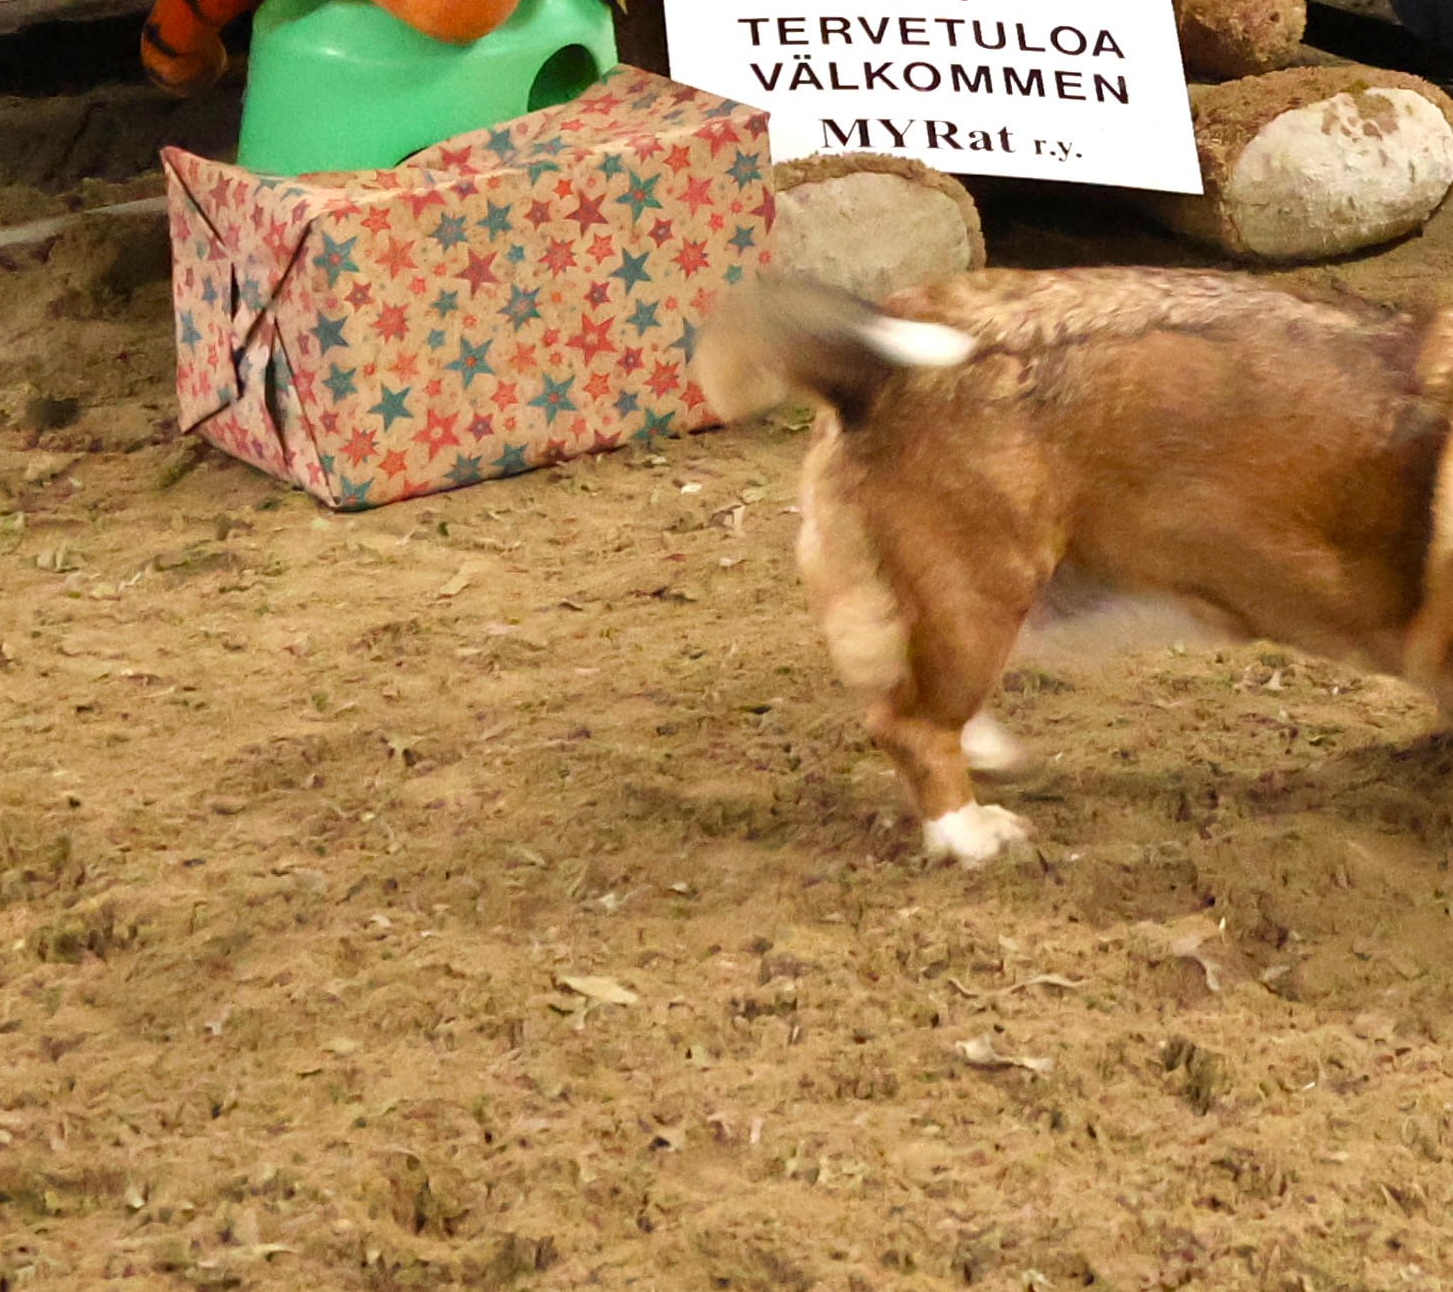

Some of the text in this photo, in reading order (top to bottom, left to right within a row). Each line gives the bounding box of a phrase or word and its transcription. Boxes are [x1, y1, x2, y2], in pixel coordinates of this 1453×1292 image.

[737, 16, 1126, 59] TERVETULOA
[749, 53, 1130, 105] VÄLKOMMEN
[818, 118, 1084, 163] MYRat r.y.
